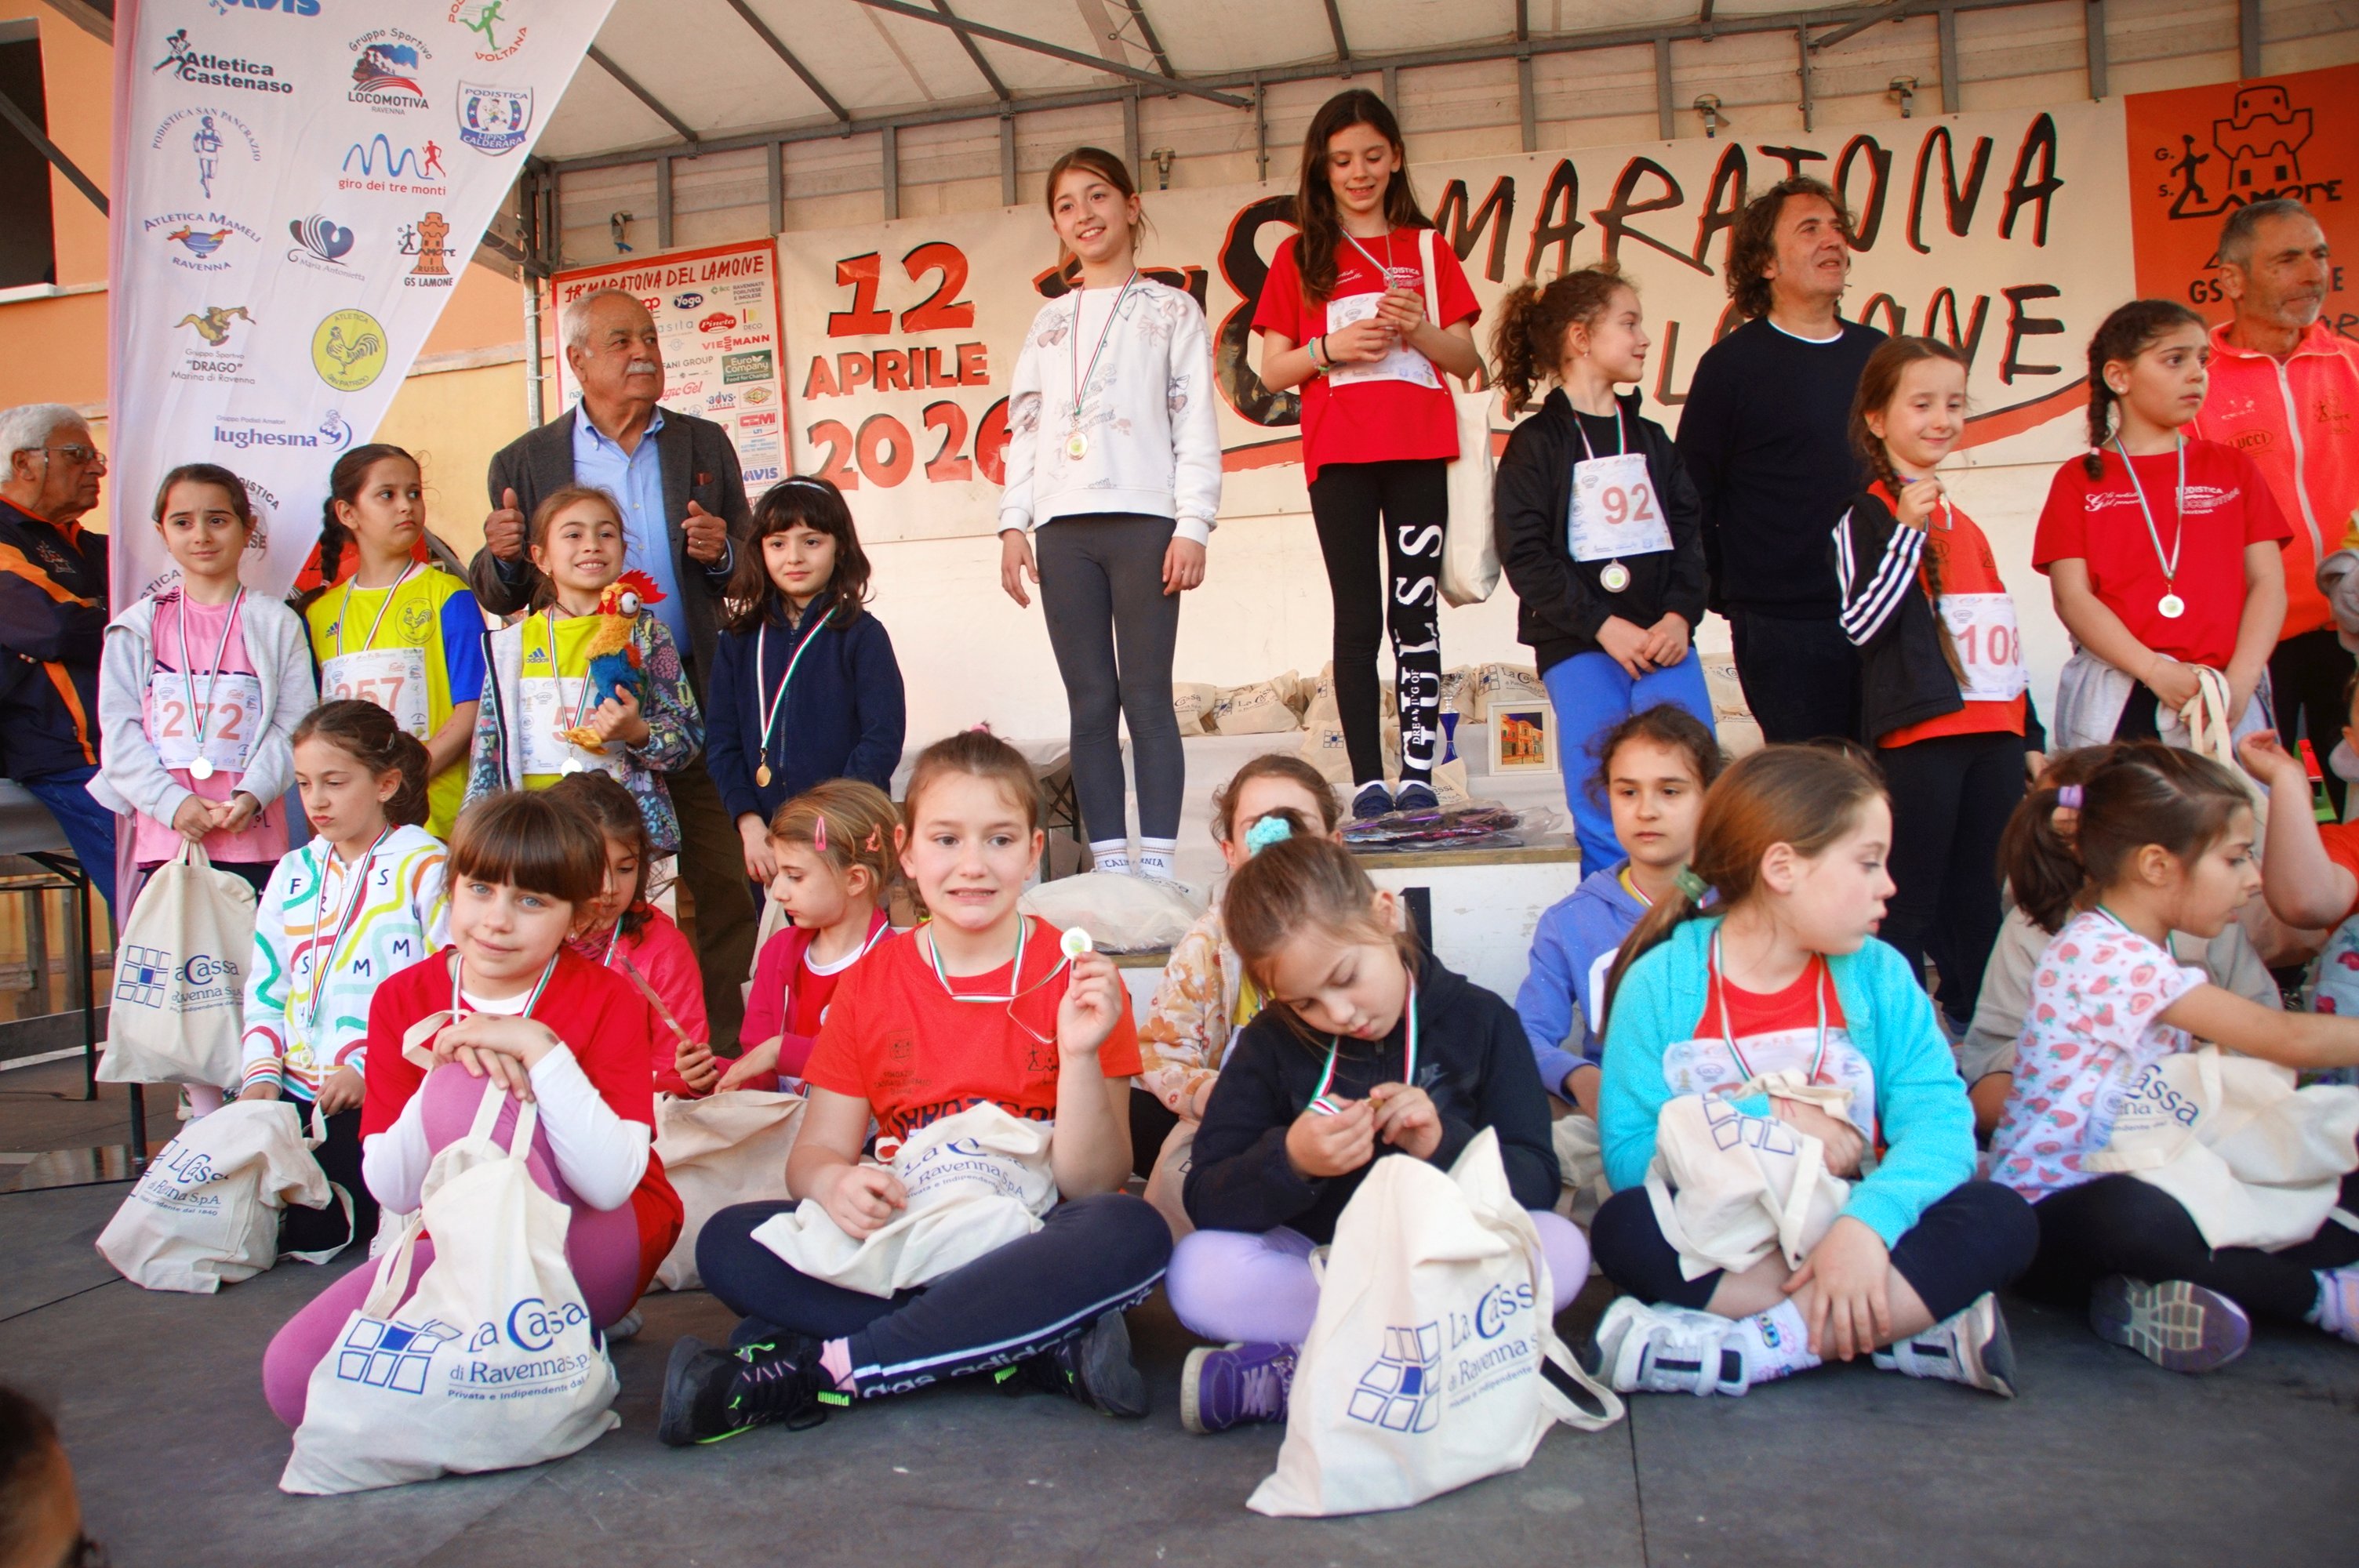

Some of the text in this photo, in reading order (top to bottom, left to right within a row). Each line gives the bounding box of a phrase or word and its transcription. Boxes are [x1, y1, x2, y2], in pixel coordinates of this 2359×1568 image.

[349, 28, 433, 60] Gruppo Sportivo
[474, 27, 528, 63] VOLTANA
[186, 52, 274, 77] Atletica
[182, 67, 293, 94] Castenaso
[348, 91, 430, 110] LOCOMOTIVA
[465, 88, 529, 100] PODISTICA
[372, 107, 405, 115] RAVENNA
[152, 107, 262, 162] PODISTICA SAN PANCRAZIO
[463, 134, 522, 148] CALDERARA
[338, 179, 447, 196] giro dei tre monti
[144, 212, 263, 243] ATLETICA MAMELI
[172, 256, 232, 272] RAVENNA
[666, 267, 696, 287] DEL
[700, 255, 765, 282] LAMONE
[404, 277, 454, 288] GS LAMONE
[732, 281, 765, 291] RAVENNATE
[827, 241, 976, 338] 12
[676, 295, 703, 308] Yoga
[333, 314, 369, 325] ATLETICA
[700, 318, 736, 328] Pineta
[743, 322, 764, 331] DECO
[702, 334, 770, 352] VIESSMANN
[185, 348, 245, 360] Gruppo Sportivo
[682, 356, 714, 368] GROUP
[731, 357, 753, 366] Euro
[725, 360, 769, 374] Company
[802, 342, 991, 401] APRILE
[171, 370, 256, 385] Marina di Ravenna
[682, 381, 703, 395] Gel
[807, 396, 1010, 491] 2026
[743, 467, 779, 482] AVIS
[238, 476, 281, 511] DISTICA
[1601, 483, 1654, 524] 92
[1501, 667, 1515, 679] La
[289, 878, 301, 895] F
[377, 869, 389, 886] S
[393, 939, 410, 957] M
[184, 954, 240, 986] Cassa
[301, 956, 310, 974] S
[353, 958, 370, 977] M
[903, 1146, 940, 1178] La
[918, 1160, 1001, 1185] Ravenna
[906, 1185, 932, 1200] rivata
[1449, 1283, 1536, 1351] La Cass
[466, 1321, 500, 1353] La
[449, 1357, 566, 1384] di Ravenna
[1458, 1339, 1528, 1385] Ravenna
[447, 1389, 485, 1400] Privata
[500, 1383, 569, 1400] Indipendente
[569, 1377, 585, 1389] dal
